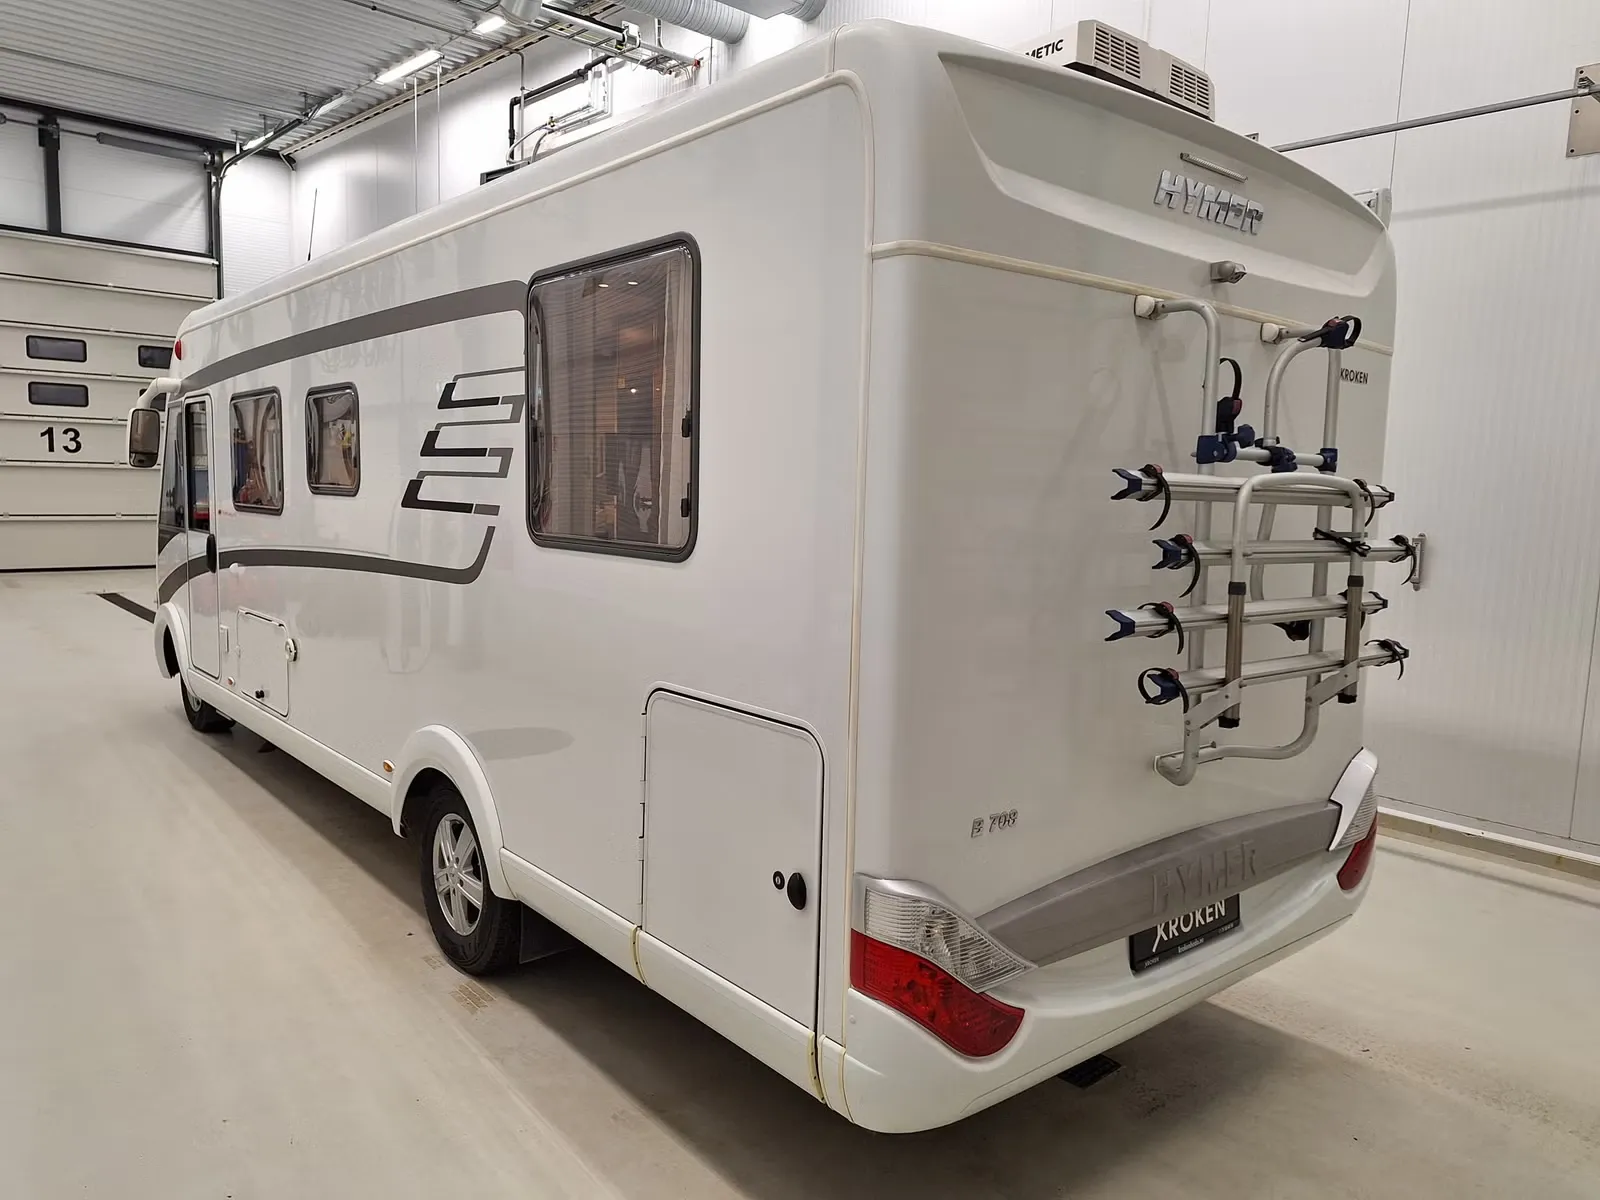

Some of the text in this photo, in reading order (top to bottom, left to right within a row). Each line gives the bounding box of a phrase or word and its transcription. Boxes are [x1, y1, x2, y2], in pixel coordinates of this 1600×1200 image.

[1153, 169, 1264, 235] HYMER
[1340, 367, 1369, 385] KROKEN
[40, 426, 82, 453] 13
[970, 808, 1019, 838] B 708
[1152, 840, 1256, 915] HYMER
[1152, 899, 1227, 953] KROKEN
